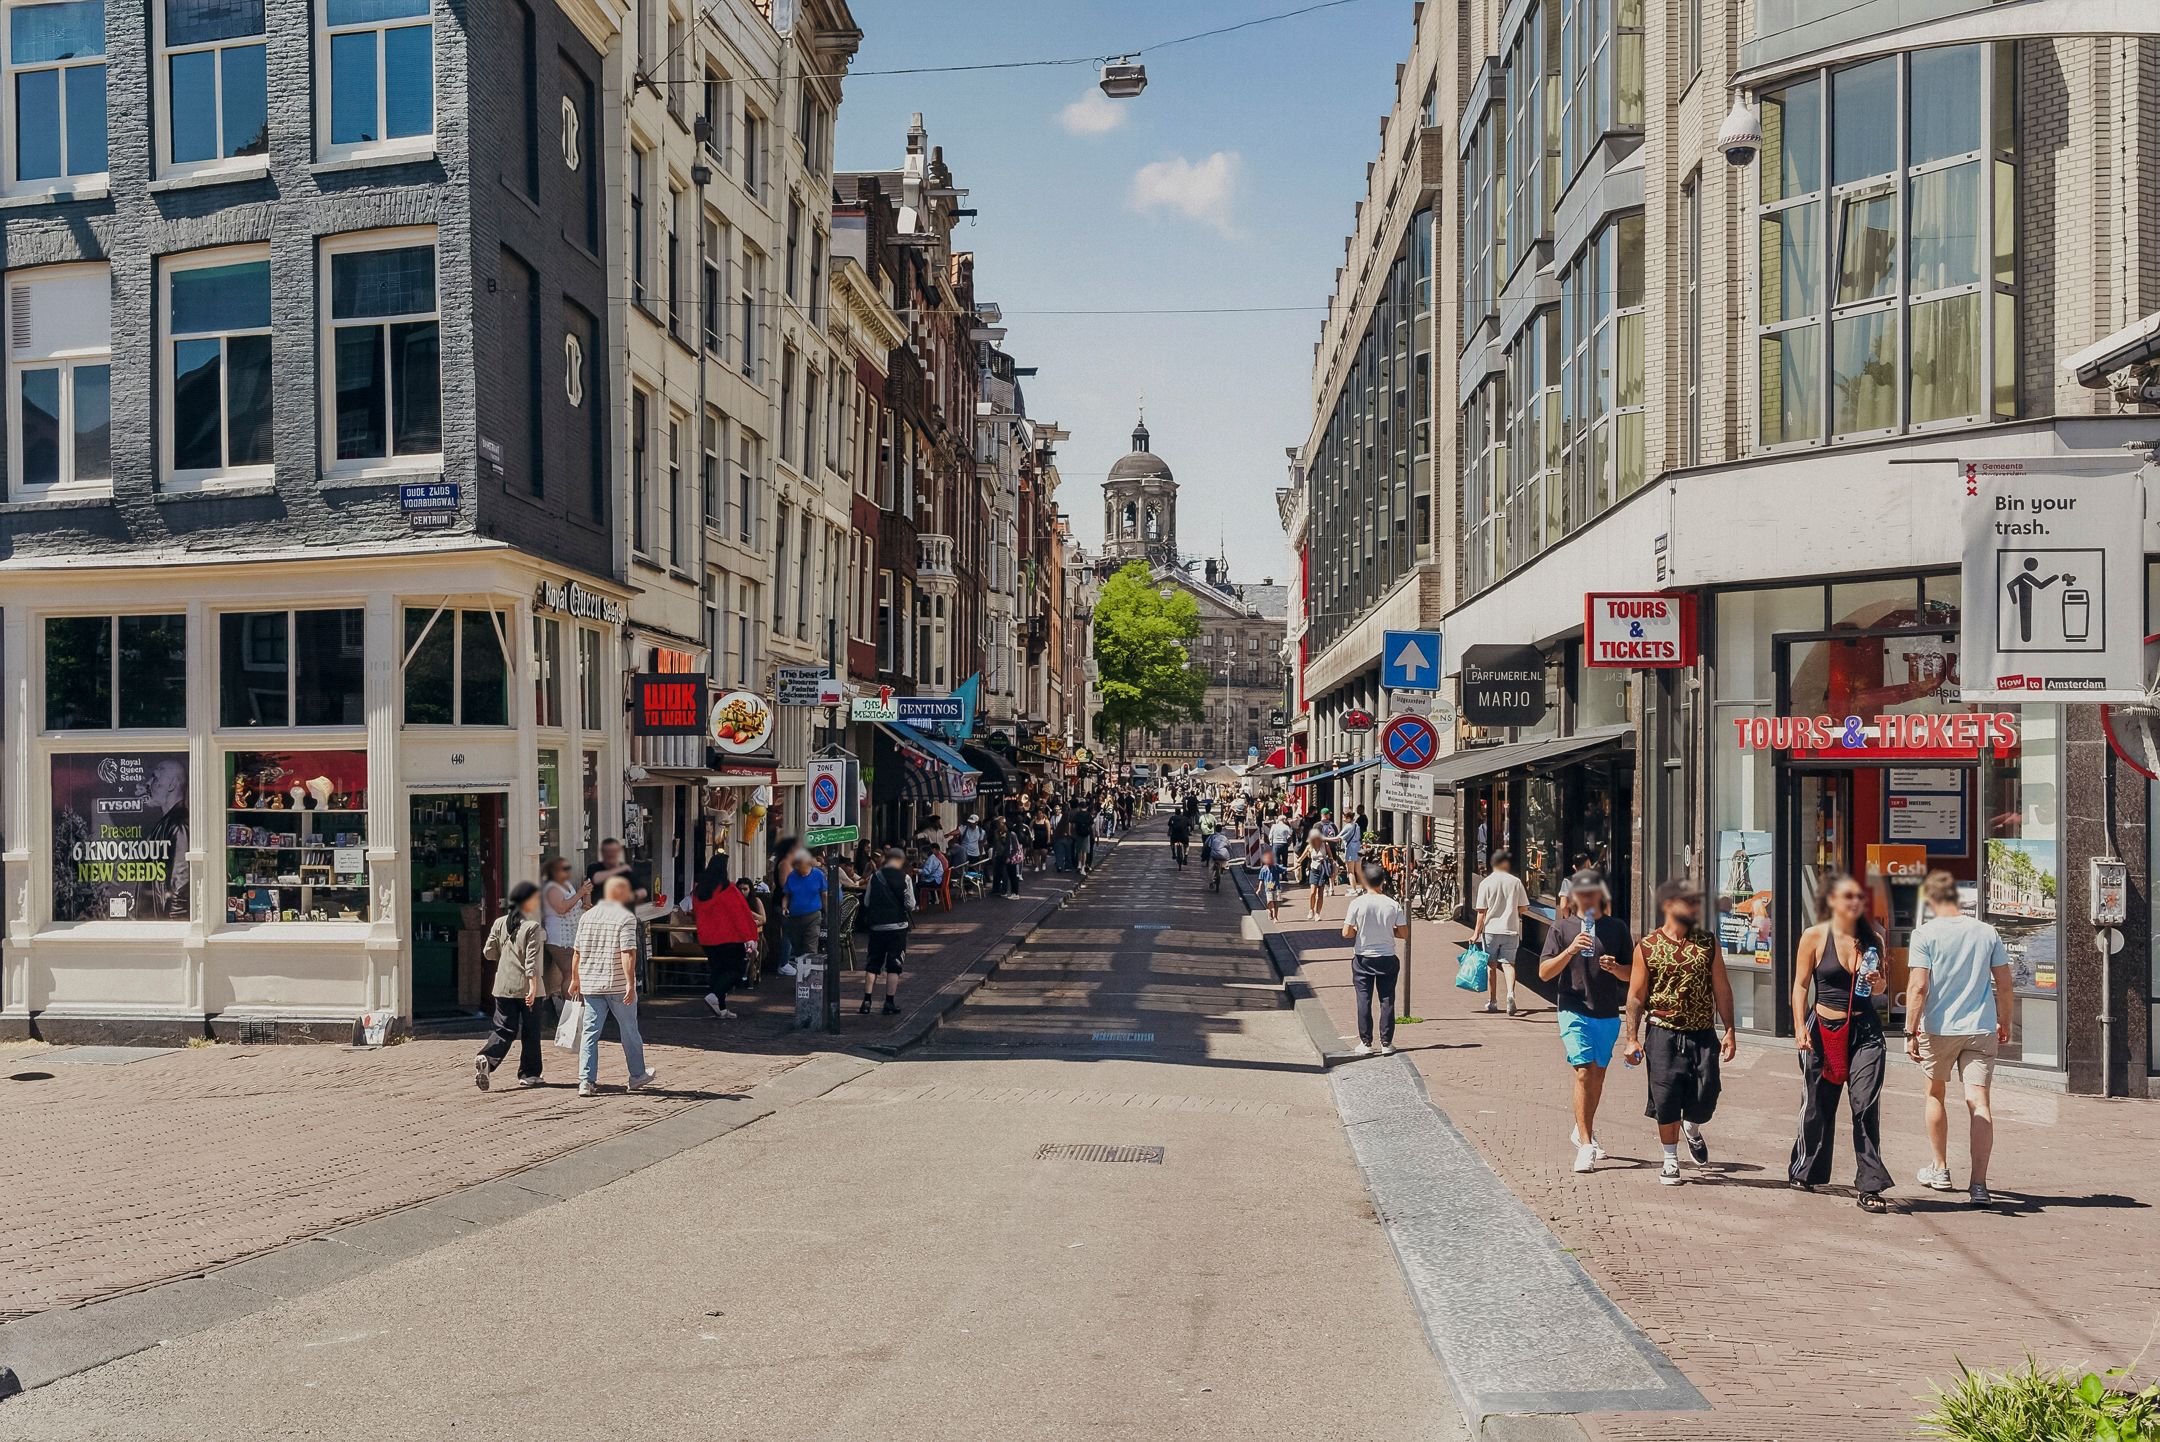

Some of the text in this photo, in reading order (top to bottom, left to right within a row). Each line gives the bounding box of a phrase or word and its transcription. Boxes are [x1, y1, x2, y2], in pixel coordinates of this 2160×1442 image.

[406, 487, 426, 497] OUDE
[403, 497, 456, 508] VOORBURGWAL
[1994, 496, 2077, 514] Bin your
[413, 515, 449, 525] CENTRUM
[1994, 519, 2050, 535] trash.
[545, 580, 625, 626] Royal Queen Seeds
[1607, 601, 1667, 619] TOURS
[1629, 621, 1644, 638] &
[1600, 641, 1675, 659] TICKETS
[779, 669, 819, 679] The best
[1471, 671, 1543, 681] PARFUMERIE.NL
[1999, 677, 2104, 690] How to Amsterdam
[643, 683, 697, 711] WOK
[1478, 691, 1530, 708] MARJO
[862, 699, 881, 710] THE
[899, 703, 958, 715] GENTINOS
[644, 710, 697, 727] TO WALK
[853, 709, 896, 720] MEXICAN
[1733, 712, 2018, 750] TOURS & TICKETS
[120, 758, 141, 767] Royal
[817, 764, 833, 772] ZONE
[120, 766, 144, 775] Queen
[120, 773, 142, 782] Seeds
[99, 800, 141, 811] TYSON
[100, 825, 142, 839] Present
[72, 840, 171, 861] 6 KNOCKOUT
[78, 862, 167, 883] NEW SEEDS
[1887, 860, 1927, 876] Cash
